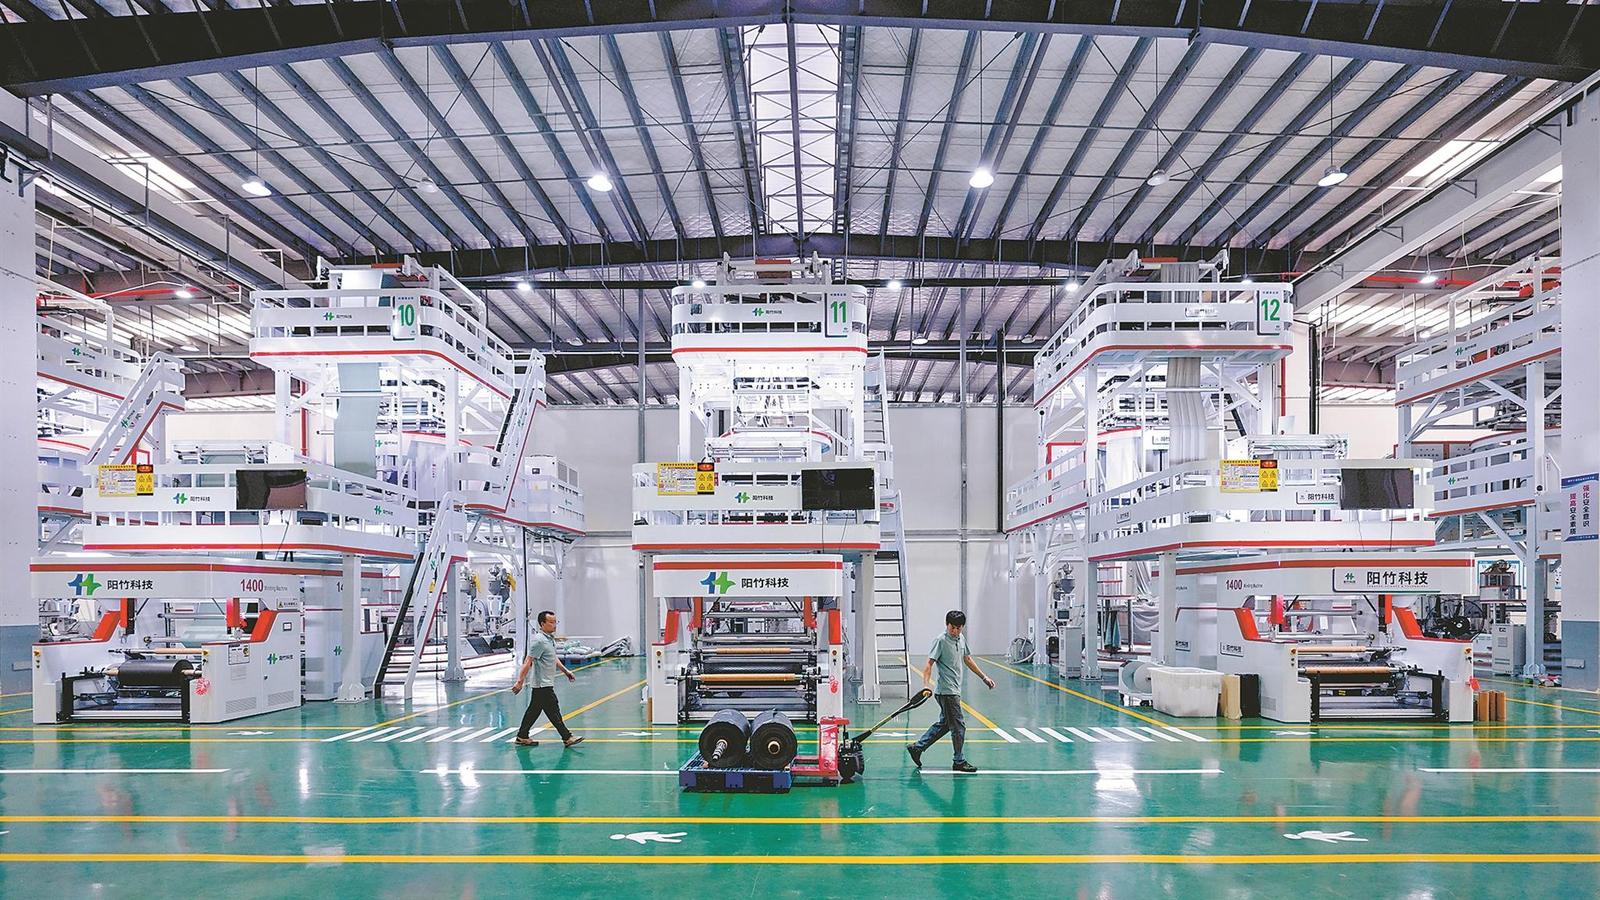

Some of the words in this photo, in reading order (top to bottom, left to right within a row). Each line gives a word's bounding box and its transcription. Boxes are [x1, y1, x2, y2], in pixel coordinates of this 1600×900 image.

[397, 304, 415, 327] 10
[830, 301, 848, 324] 11
[1261, 298, 1281, 321] 12
[741, 578, 789, 588] 阳竹科技
[1226, 579, 1243, 590] 1400
[1366, 571, 1428, 585] 阳竹科技
[107, 580, 153, 590] 阳竹科技
[240, 579, 264, 592] 1400
